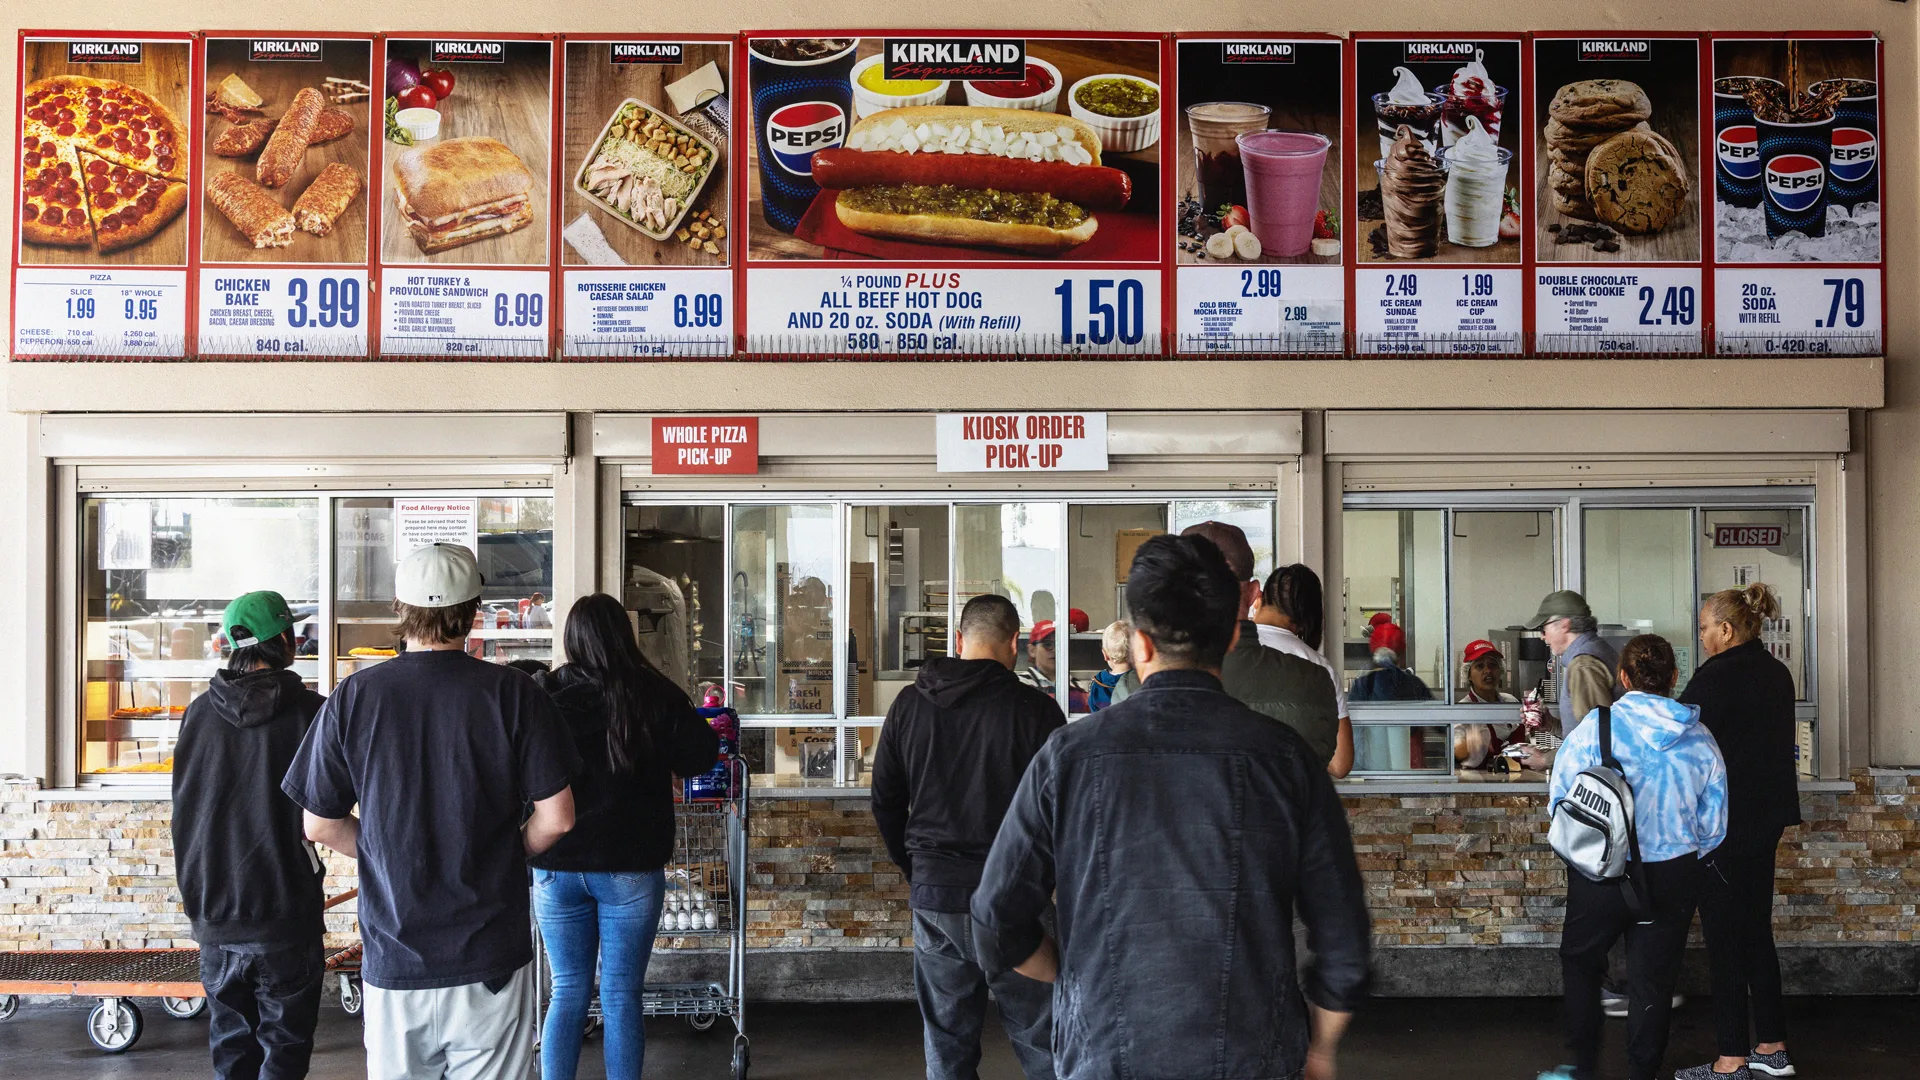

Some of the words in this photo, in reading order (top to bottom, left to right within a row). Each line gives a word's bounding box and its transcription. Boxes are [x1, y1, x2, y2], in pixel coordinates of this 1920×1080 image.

[72, 44, 138, 54] KIRKLAND
[254, 42, 319, 53] KIRKLAND
[435, 43, 501, 53] KIRKLAND
[615, 45, 680, 55] KIRKLAND
[892, 44, 1019, 63] KIRKLAND
[1227, 45, 1291, 54] KIRKLAND
[1408, 44, 1473, 54] KIRKLAND
[1583, 42, 1647, 52] KIRKLAND
[892, 63, 1019, 81] Signature
[771, 122, 842, 146] PEPSI
[1720, 143, 1759, 158] PEP
[1831, 145, 1874, 160] EPSI
[1768, 173, 1821, 189] PEPSI
[215, 279, 270, 291] CHICKEN
[408, 277, 424, 285] HOT
[428, 277, 460, 285] TURKEY
[630, 283, 666, 291] CHICKEN
[857, 276, 901, 288] POUND
[905, 273, 960, 288] PLUS
[1241, 270, 1281, 297] 2.99
[1386, 274, 1417, 296] 2.49
[1462, 274, 1492, 296] 1.99
[1539, 276, 1577, 285] DOUBLE
[1581, 276, 1638, 285] CHOCOLATE
[390, 287, 440, 296] PROVOLONE
[443, 288, 488, 297] SANDWICH
[1552, 287, 1586, 296] CHUNK
[1589, 287, 1624, 296] COOKIE
[1742, 284, 1757, 295] 20
[1761, 287, 1775, 295] oz.
[226, 294, 259, 305] BAKE
[288, 278, 359, 328] 3.99
[820, 292, 852, 308] ALL
[859, 292, 899, 308] BEEF
[906, 292, 940, 308] HOT
[947, 292, 982, 308] DOG
[1639, 286, 1694, 325] 2.49
[1743, 298, 1776, 310] SODA
[1816, 278, 1864, 328] .79
[66, 298, 95, 318] 1.99
[125, 299, 157, 320] 9.95
[495, 293, 542, 327] 6.99
[674, 294, 722, 327] 6.99
[1055, 279, 1143, 345] 1.50
[1285, 307, 1307, 320] 2.99
[229, 318, 248, 326] CAESAR
[250, 318, 274, 326] DRESSING
[787, 313, 823, 328] AND
[830, 313, 849, 328] 20
[856, 317, 878, 328] oz.
[886, 313, 932, 328] SODA
[939, 315, 975, 331] (With
[979, 315, 1021, 332] Refill)
[1739, 313, 1756, 323] WITH
[1759, 313, 1780, 323] REFILL
[257, 339, 280, 351] 840
[284, 339, 308, 351] cal.
[446, 343, 462, 351] 820
[466, 343, 481, 351] cal.
[848, 333, 879, 349] 580
[897, 333, 927, 349] 850
[933, 333, 962, 349] cal.
[1599, 341, 1616, 350] 750
[1621, 341, 1638, 350] cal.
[1810, 340, 1831, 351] cal.
[652, 345, 667, 353] cal.
[662, 427, 708, 443] WHOLE
[711, 427, 747, 443] PIZZA
[963, 416, 1022, 440] KIOSK
[1026, 416, 1084, 439] ORDER
[678, 448, 732, 465] PICK-UP
[986, 444, 1063, 468] PICK-UP
[1720, 529, 1778, 544] CLOSED
[1573, 784, 1611, 818] PUMA
